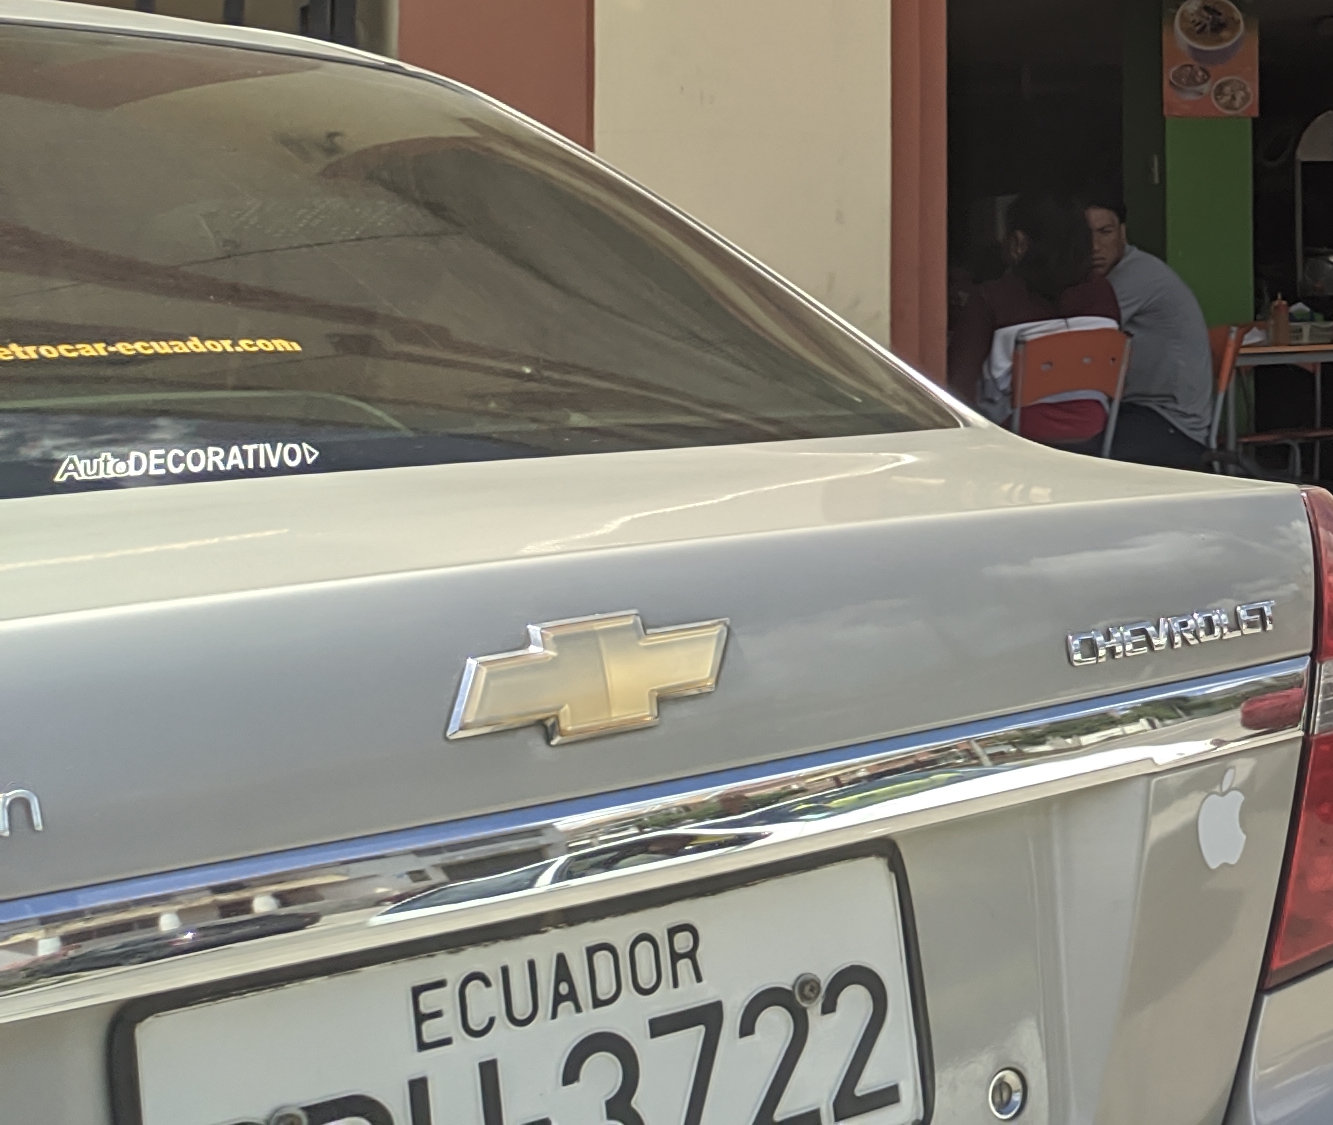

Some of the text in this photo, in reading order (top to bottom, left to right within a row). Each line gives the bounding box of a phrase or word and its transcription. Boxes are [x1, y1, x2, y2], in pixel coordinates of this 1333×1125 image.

[1066, 600, 1277, 666] CHEVROLET
[225, 964, 901, 1125] -3722
[411, 922, 705, 1052] ECUADOR
